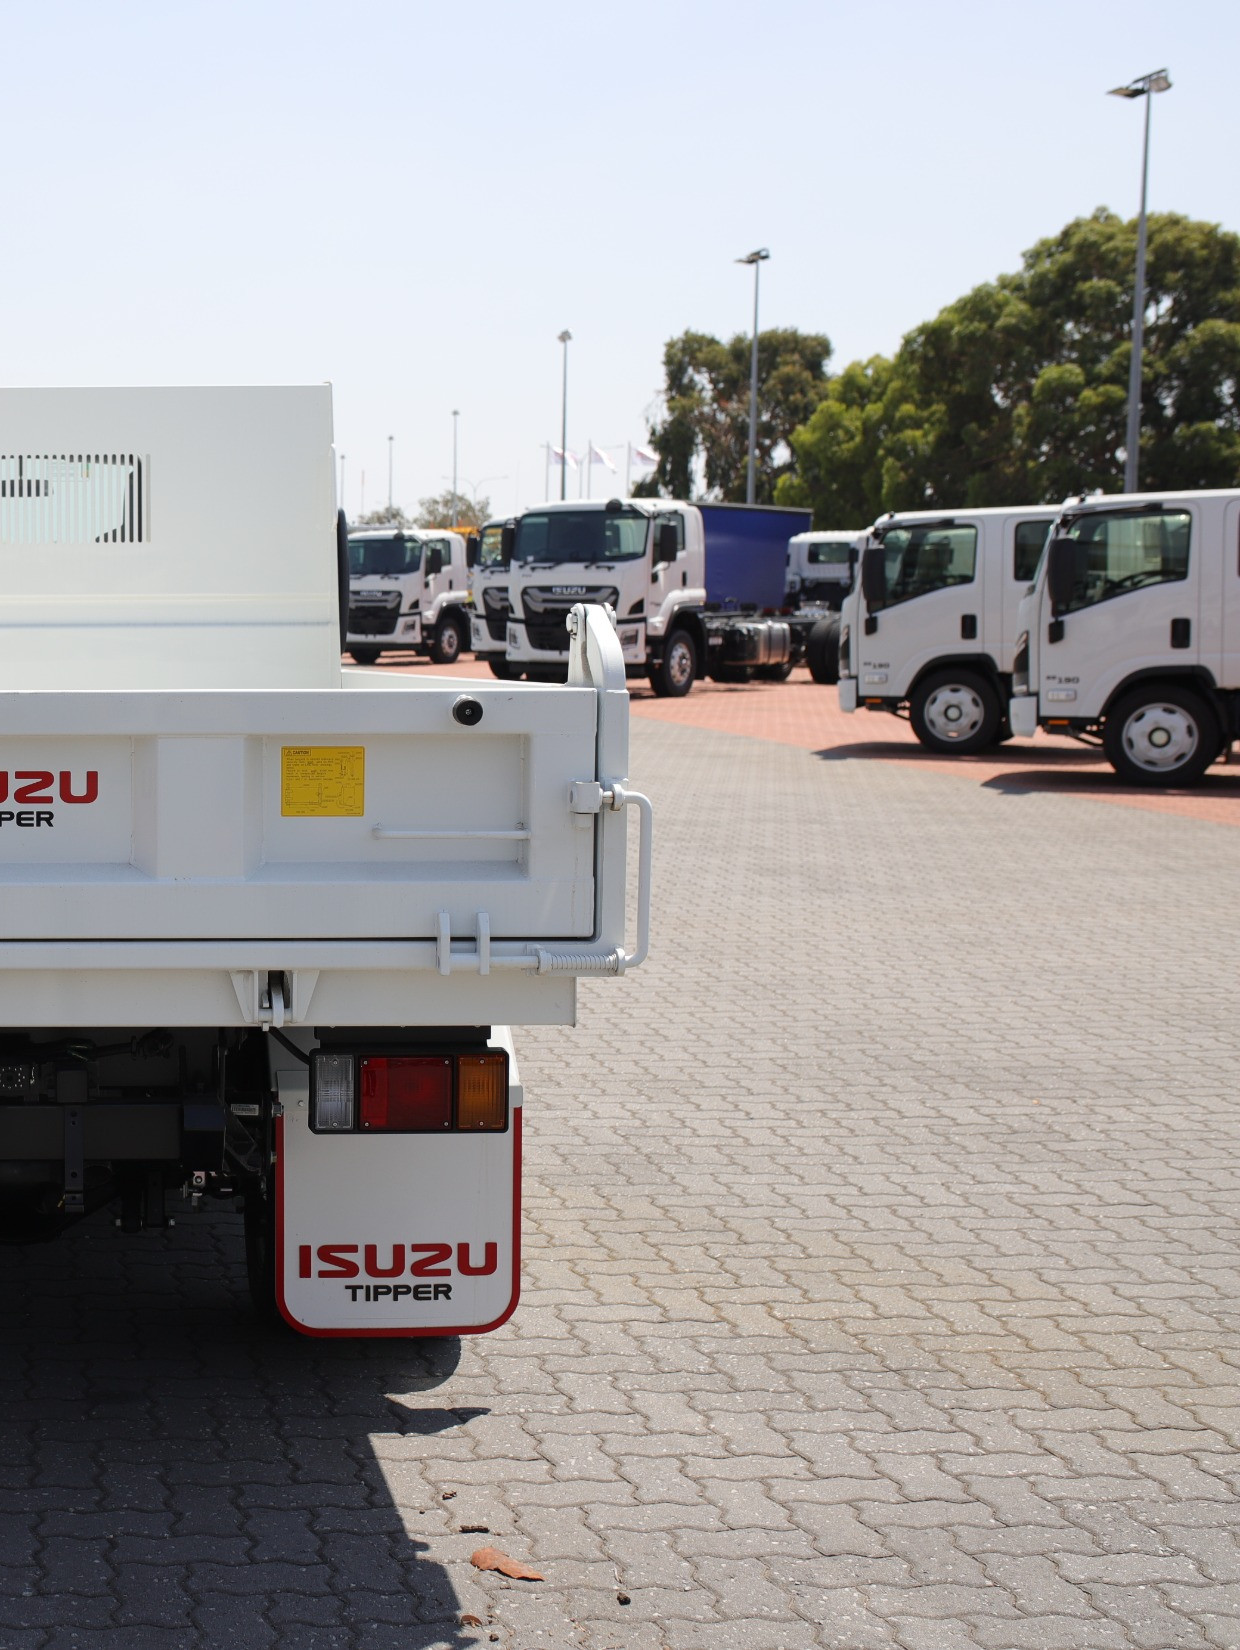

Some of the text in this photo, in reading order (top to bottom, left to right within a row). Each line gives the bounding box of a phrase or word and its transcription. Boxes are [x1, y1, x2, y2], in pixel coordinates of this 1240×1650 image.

[552, 586, 586, 595] ISUZU
[299, 1242, 498, 1279] ISUZU
[345, 1284, 453, 1302] TIPPER
